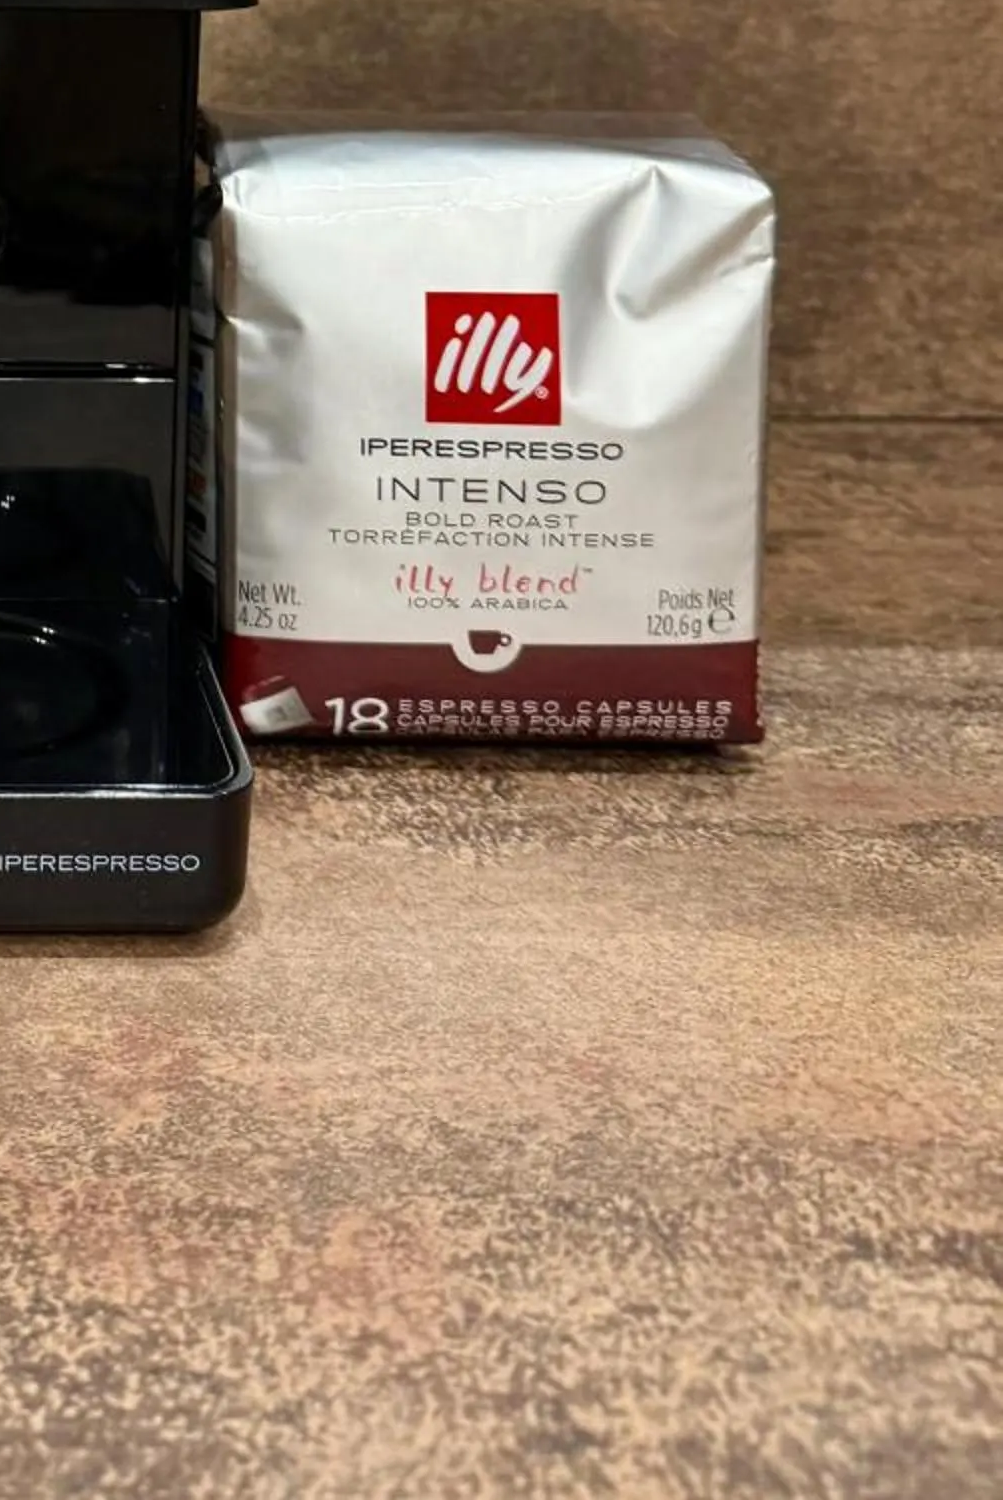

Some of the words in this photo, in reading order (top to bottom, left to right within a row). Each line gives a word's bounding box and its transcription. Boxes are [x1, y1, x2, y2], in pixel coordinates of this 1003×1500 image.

[360, 437, 624, 461] IPERESPRESSO
[377, 477, 607, 505] INTENSO
[405, 511, 476, 528] BOLD
[488, 513, 580, 529] ROAST
[542, 532, 655, 548] INTENSE
[394, 563, 455, 597] illy
[238, 580, 267, 603] Net
[272, 583, 302, 606] Wt.
[407, 597, 460, 609] 100%
[469, 598, 568, 610] ARABICA
[658, 587, 703, 610] Poids
[708, 587, 735, 609] Net
[238, 606, 273, 629] 4.25
[278, 614, 298, 631] oz
[324, 696, 390, 736] 18
[399, 699, 560, 714] ESPRESSO
[576, 700, 733, 715] CAPSULES
[396, 713, 521, 727] CAPSULES
[529, 715, 592, 728] POUR
[600, 715, 730, 729] ESPRESSO
